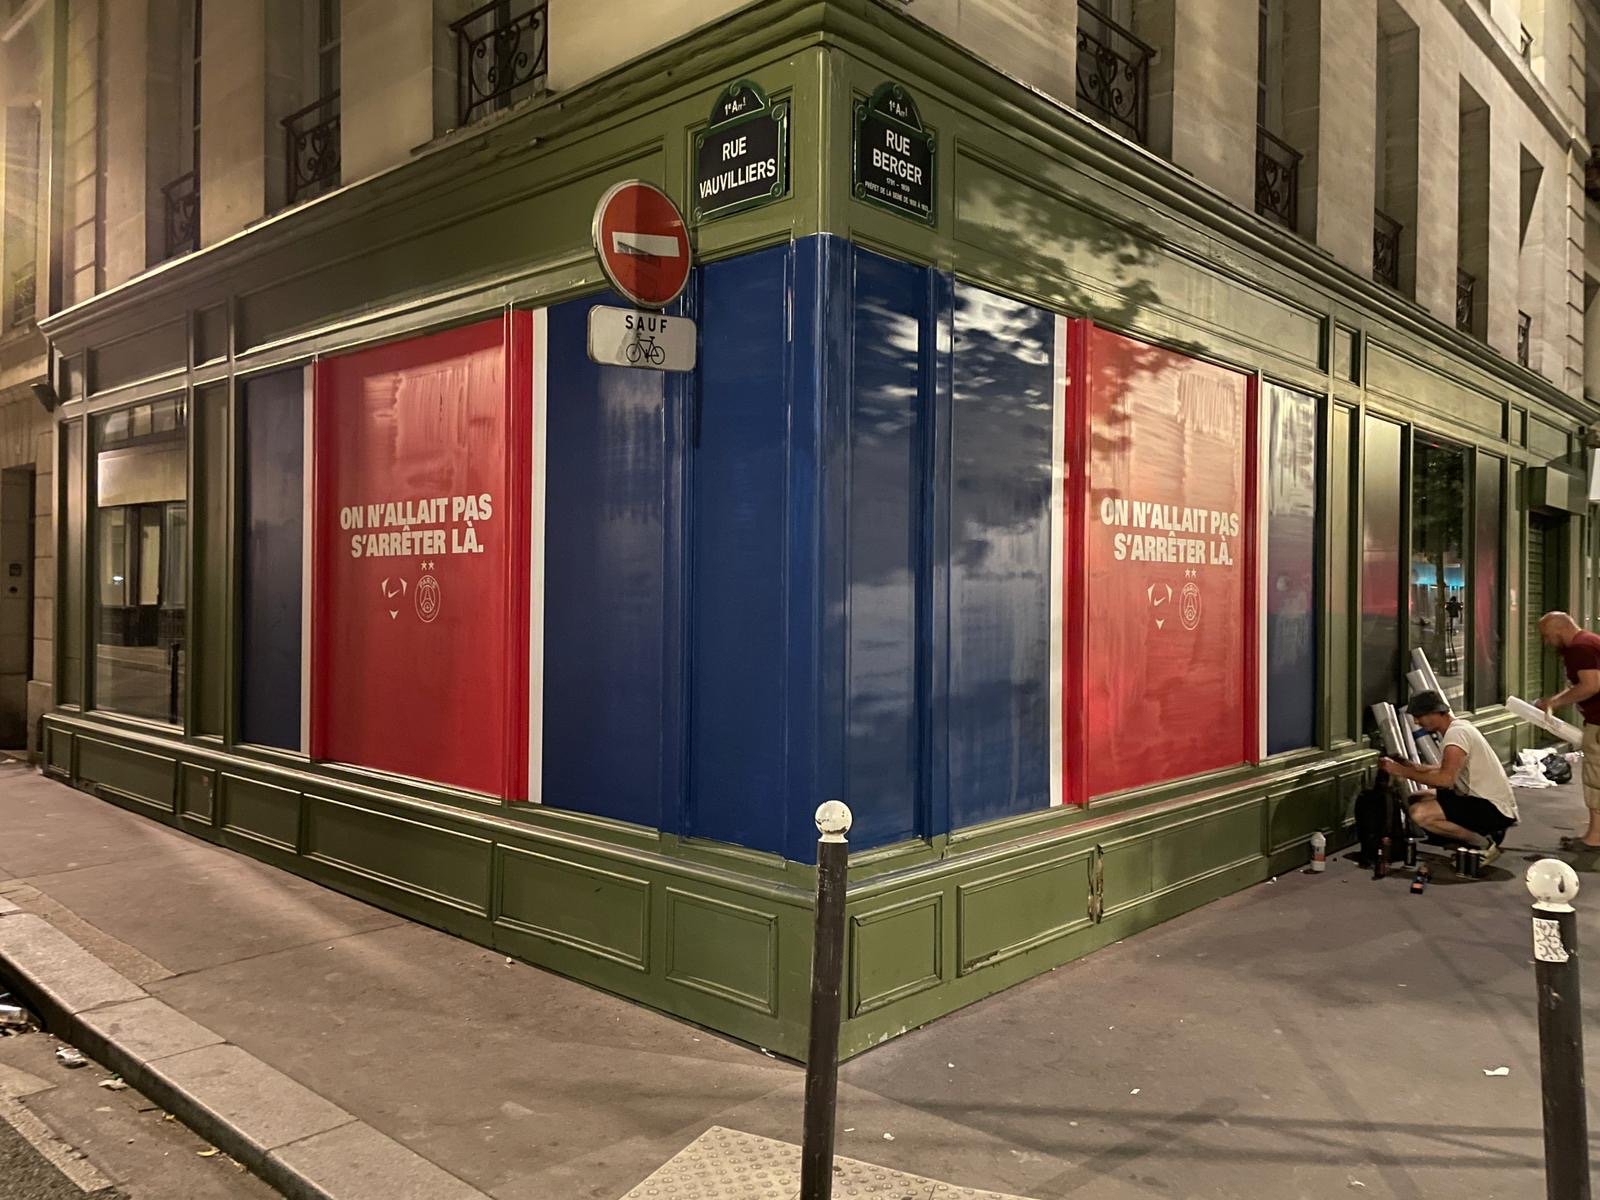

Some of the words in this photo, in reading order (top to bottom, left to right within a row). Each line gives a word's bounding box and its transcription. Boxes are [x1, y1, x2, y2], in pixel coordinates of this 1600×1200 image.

[722, 136, 747, 161] RUE
[886, 129, 911, 157] RUE
[699, 158, 776, 199] VAUVILLIERS
[872, 148, 923, 186] BERGER
[625, 315, 668, 333] SAUF
[340, 505, 364, 530] ON
[367, 497, 449, 528] N'ALLAIT
[452, 493, 493, 523] PAS
[1101, 497, 1129, 526] ON
[1132, 501, 1208, 534] N'ALLAIT
[1210, 510, 1240, 537] PAS
[351, 525, 447, 558] S'ARRÊTER
[451, 520, 485, 554] LÀ.
[1113, 531, 1206, 564] S'ARRÊTER
[1210, 535, 1234, 565] LÀ.
